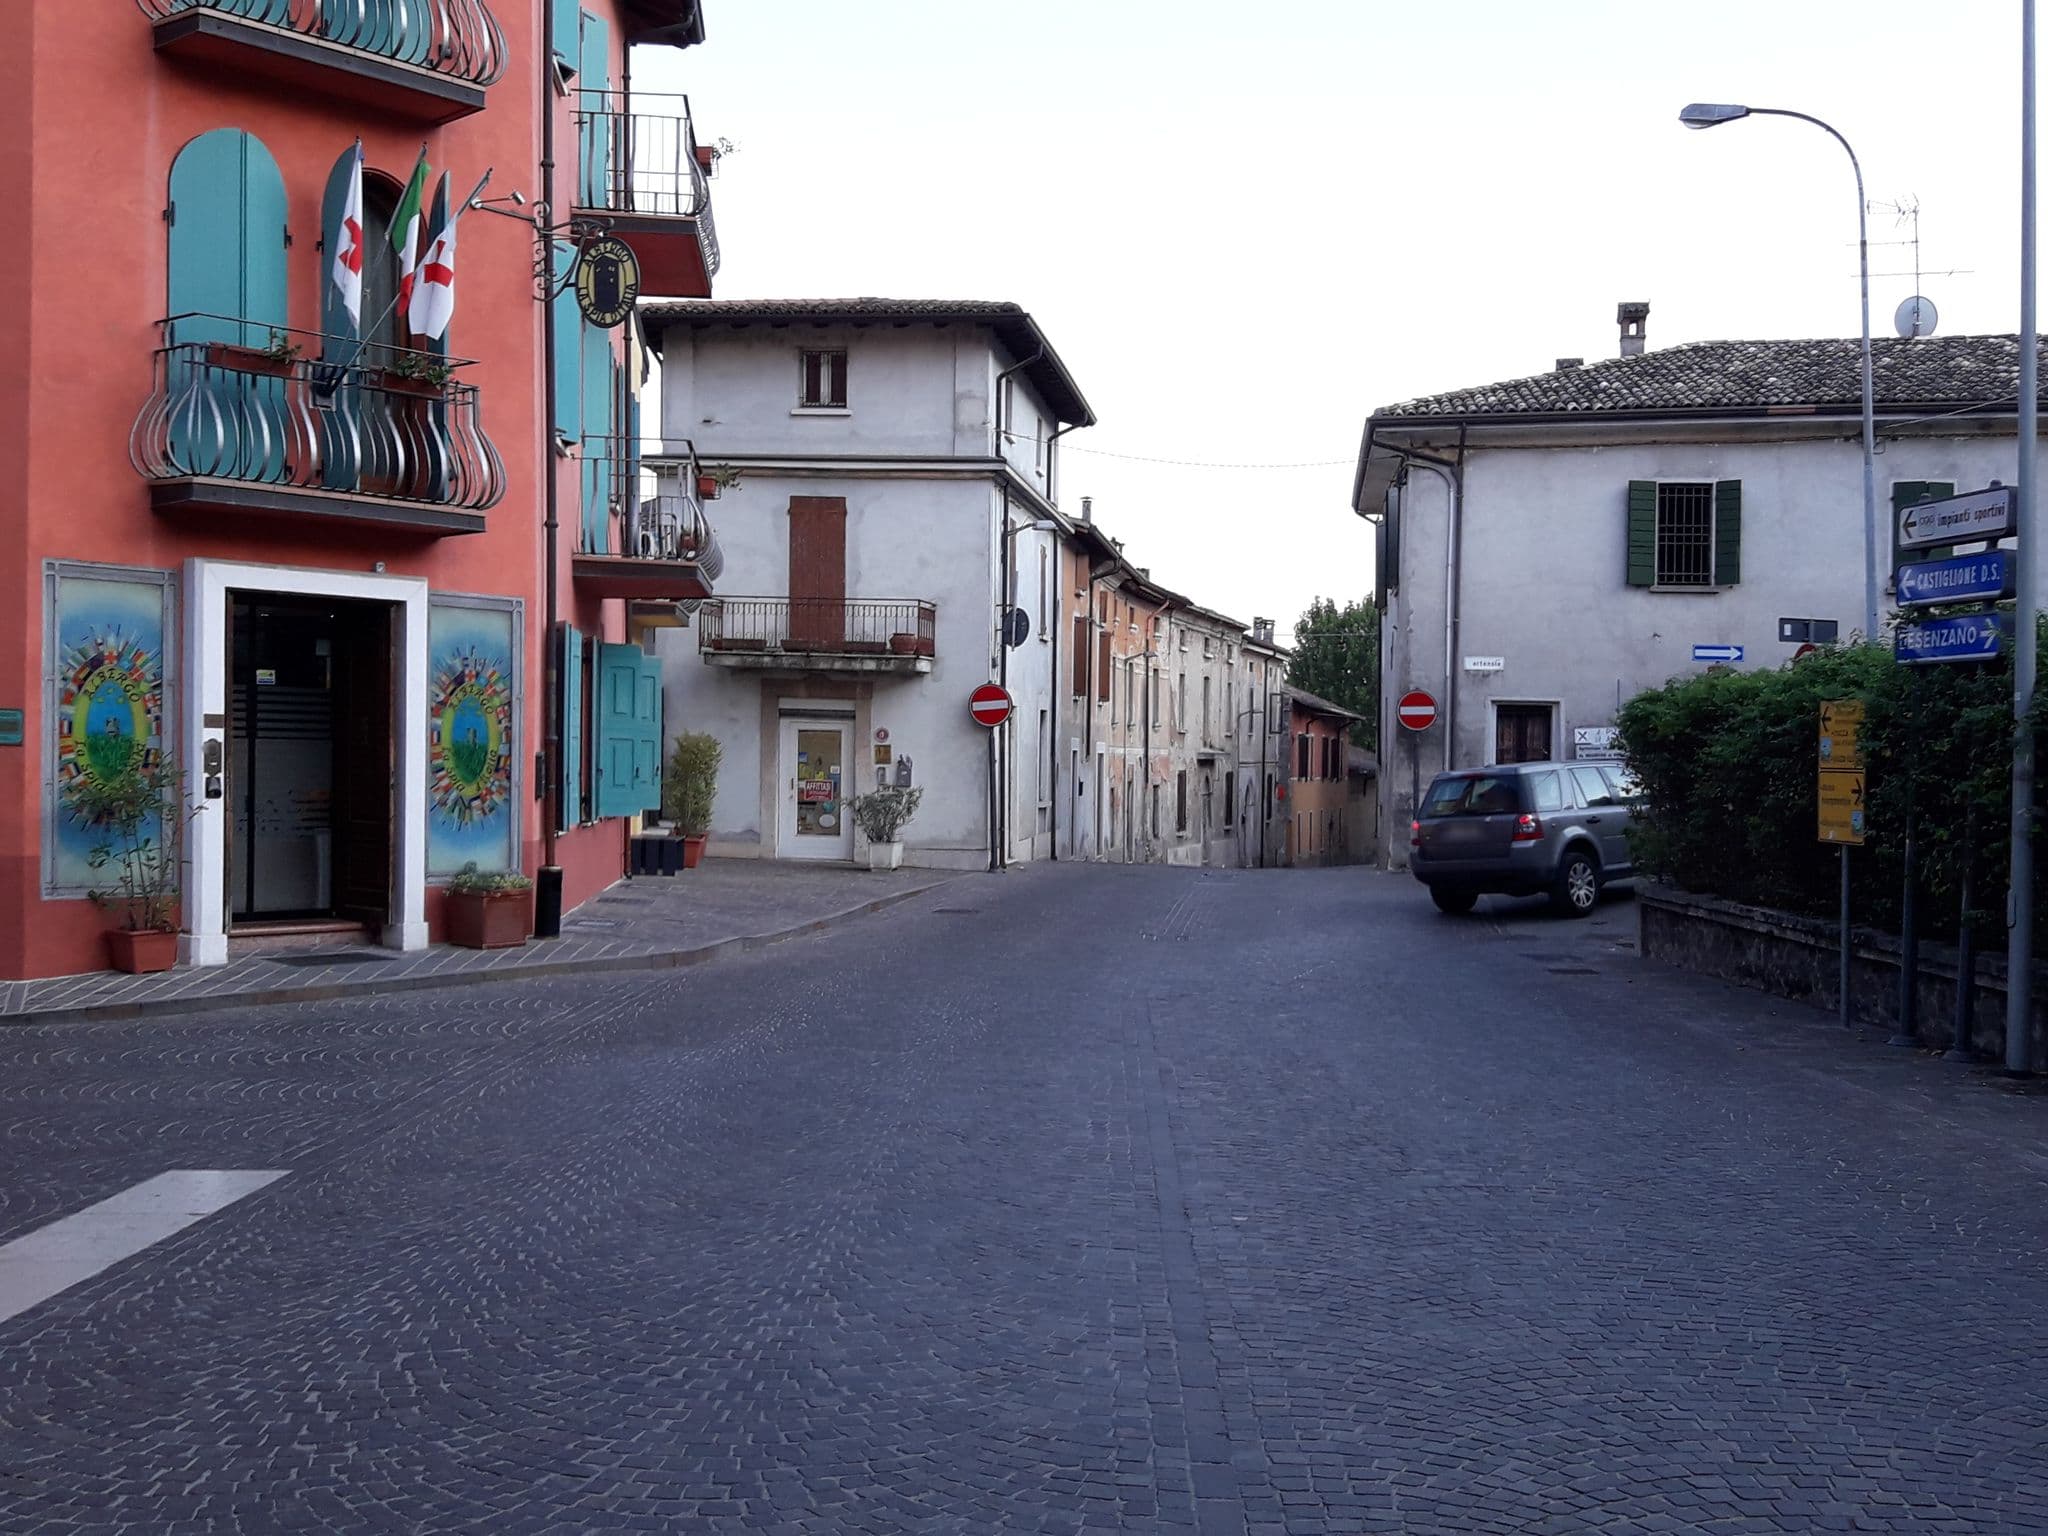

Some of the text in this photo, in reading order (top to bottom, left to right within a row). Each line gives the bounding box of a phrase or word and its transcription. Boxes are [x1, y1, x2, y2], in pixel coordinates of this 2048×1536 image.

[583, 242, 630, 267] ALBERGO
[1937, 501, 2006, 528] impianti sportivi
[1917, 562, 2001, 591] CASTIGLIONE D.S.
[84, 667, 141, 703] ALBERGO
[447, 684, 494, 714] ALBERGO
